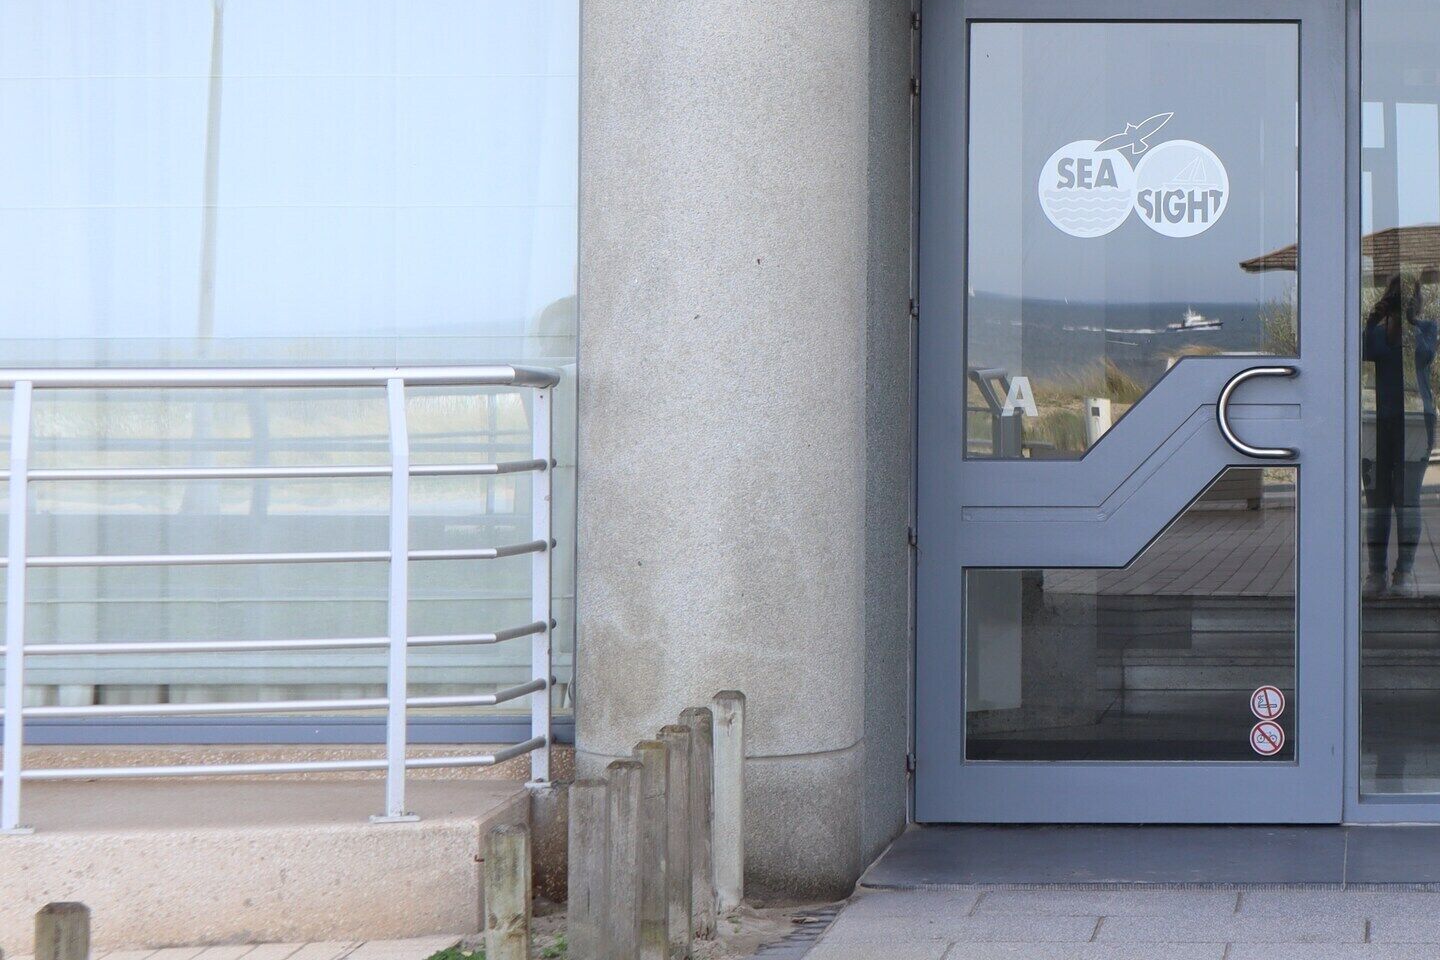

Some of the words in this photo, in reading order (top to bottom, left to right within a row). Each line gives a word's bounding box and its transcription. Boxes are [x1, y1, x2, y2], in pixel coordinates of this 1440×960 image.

[1056, 157, 1119, 189] SEA
[1137, 189, 1224, 224] SIGHT
[1001, 376, 1039, 417] A
